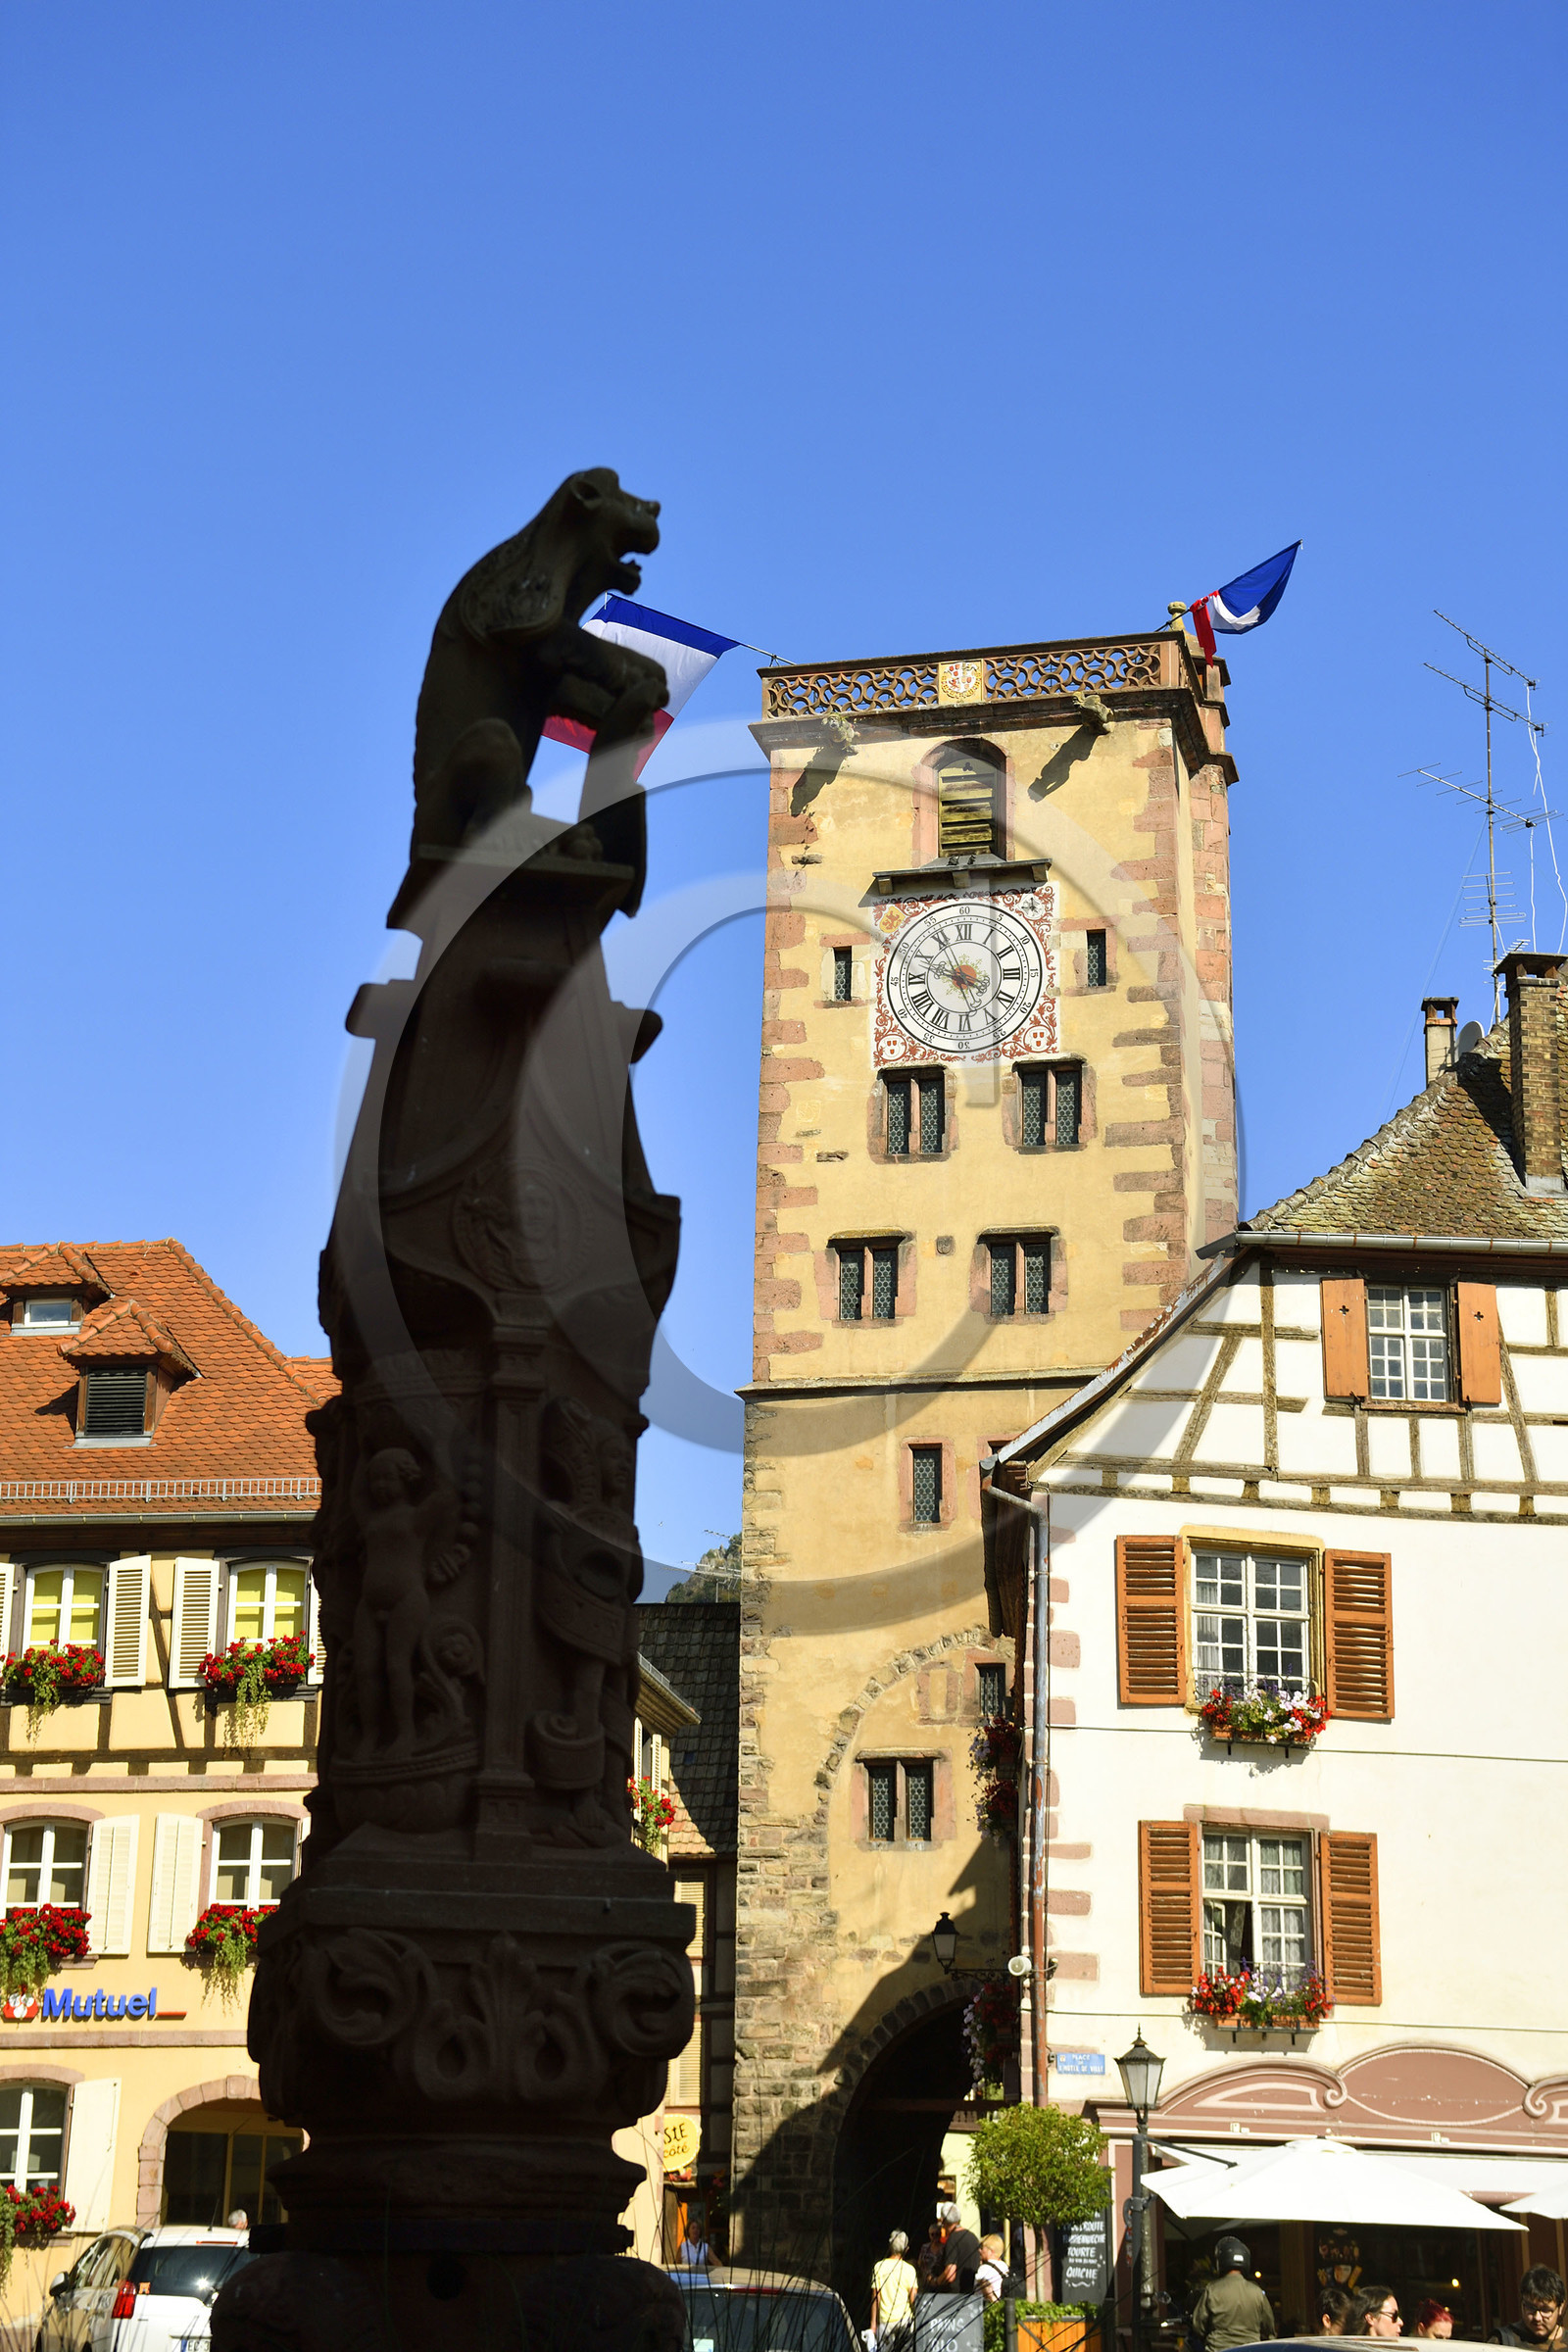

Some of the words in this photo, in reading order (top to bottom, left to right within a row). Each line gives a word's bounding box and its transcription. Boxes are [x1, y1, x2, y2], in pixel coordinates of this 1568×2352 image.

[958, 906, 970, 915] 60
[923, 916, 937, 927] 55
[955, 924, 973, 941] XII
[982, 929, 995, 945] I
[931, 929, 951, 951] XI
[1019, 935, 1031, 945] 10
[898, 942, 910, 955] 50
[996, 945, 1015, 960] II
[913, 949, 934, 963] X
[908, 972, 927, 986] IX
[1003, 967, 1020, 981] III
[1030, 967, 1039, 978] 15
[891, 976, 900, 987] 45
[910, 991, 935, 1017] VIII
[996, 990, 1015, 1010] IV
[897, 1007, 908, 1019] 40
[1019, 1002, 1032, 1014] 20
[929, 1007, 951, 1030] VII
[983, 1007, 998, 1025] V
[957, 1014, 972, 1032] VI
[922, 1032, 935, 1044] 35
[993, 1029, 1006, 1041] 25
[957, 1041, 970, 1050] 30
[42, 1986, 158, 2018] Mutuel
[1067, 2246, 1097, 2258] TOURTE
[1066, 2266, 1098, 2279] QUICHE
